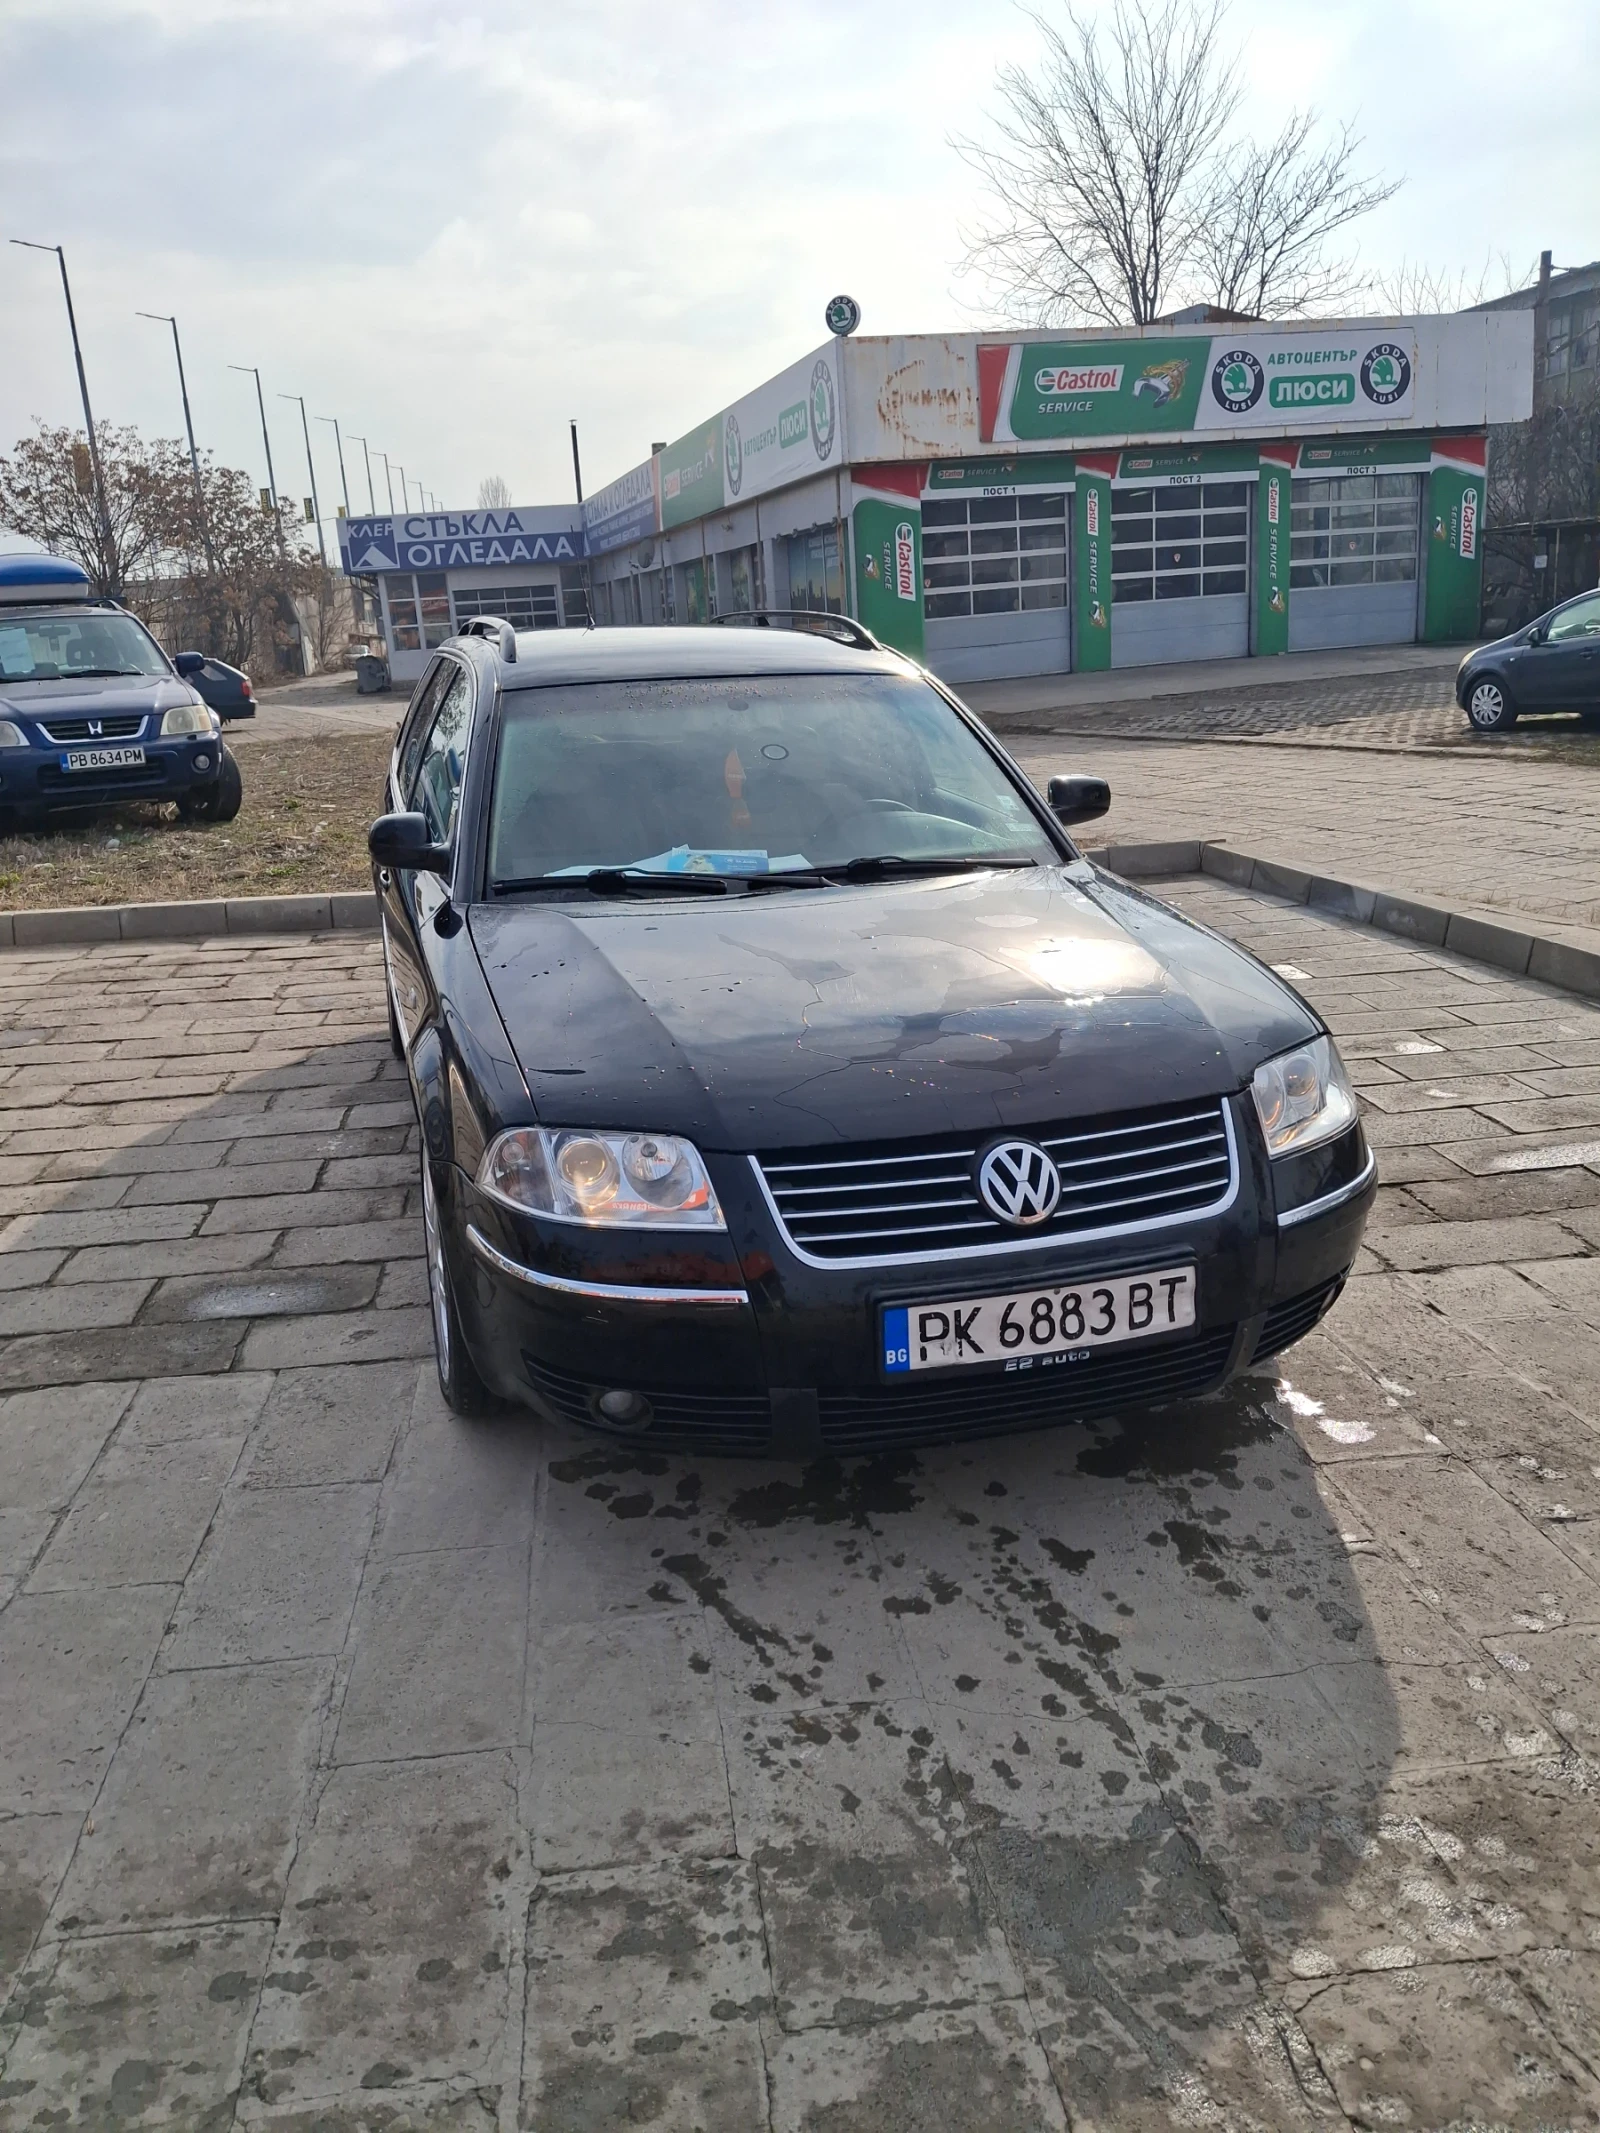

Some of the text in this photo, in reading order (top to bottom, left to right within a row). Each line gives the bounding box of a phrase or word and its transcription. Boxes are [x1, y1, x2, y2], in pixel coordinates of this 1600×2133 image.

[827, 298, 853, 315] SKODA
[1216, 352, 1260, 375] SKODA
[1267, 350, 1358, 366] АВТОЦЕНТЪР
[1364, 346, 1408, 368] SKODA
[1057, 368, 1117, 390] Castrol
[1276, 380, 1348, 402] ЛЮСИ
[1372, 391, 1399, 403] LUSI
[1038, 401, 1093, 414] SERVICE
[1225, 400, 1252, 411] LUSI
[781, 409, 806, 440] ЛЮСИ
[966, 468, 998, 477] SERVICE
[1169, 475, 1202, 485] ПОСТ 2
[1347, 466, 1377, 475] ПОСТ 3
[983, 487, 1009, 496] ПОСТ
[404, 511, 525, 539] СТЪКЛА
[1449, 505, 1457, 550] SERVICE
[1462, 505, 1475, 555] Castrol
[407, 535, 575, 567] ОГЛЕДАЛА
[1089, 500, 1098, 594] Castrol SERVICE
[884, 541, 893, 591] SERVICE
[899, 542, 914, 595] Castrol
[69, 754, 88, 767] PB
[90, 751, 122, 766] 8634
[124, 749, 143, 763] PM
[918, 1275, 1188, 1362] PK 6883 BT
[886, 1350, 907, 1364] BG
[1042, 1349, 1091, 1367] auto
